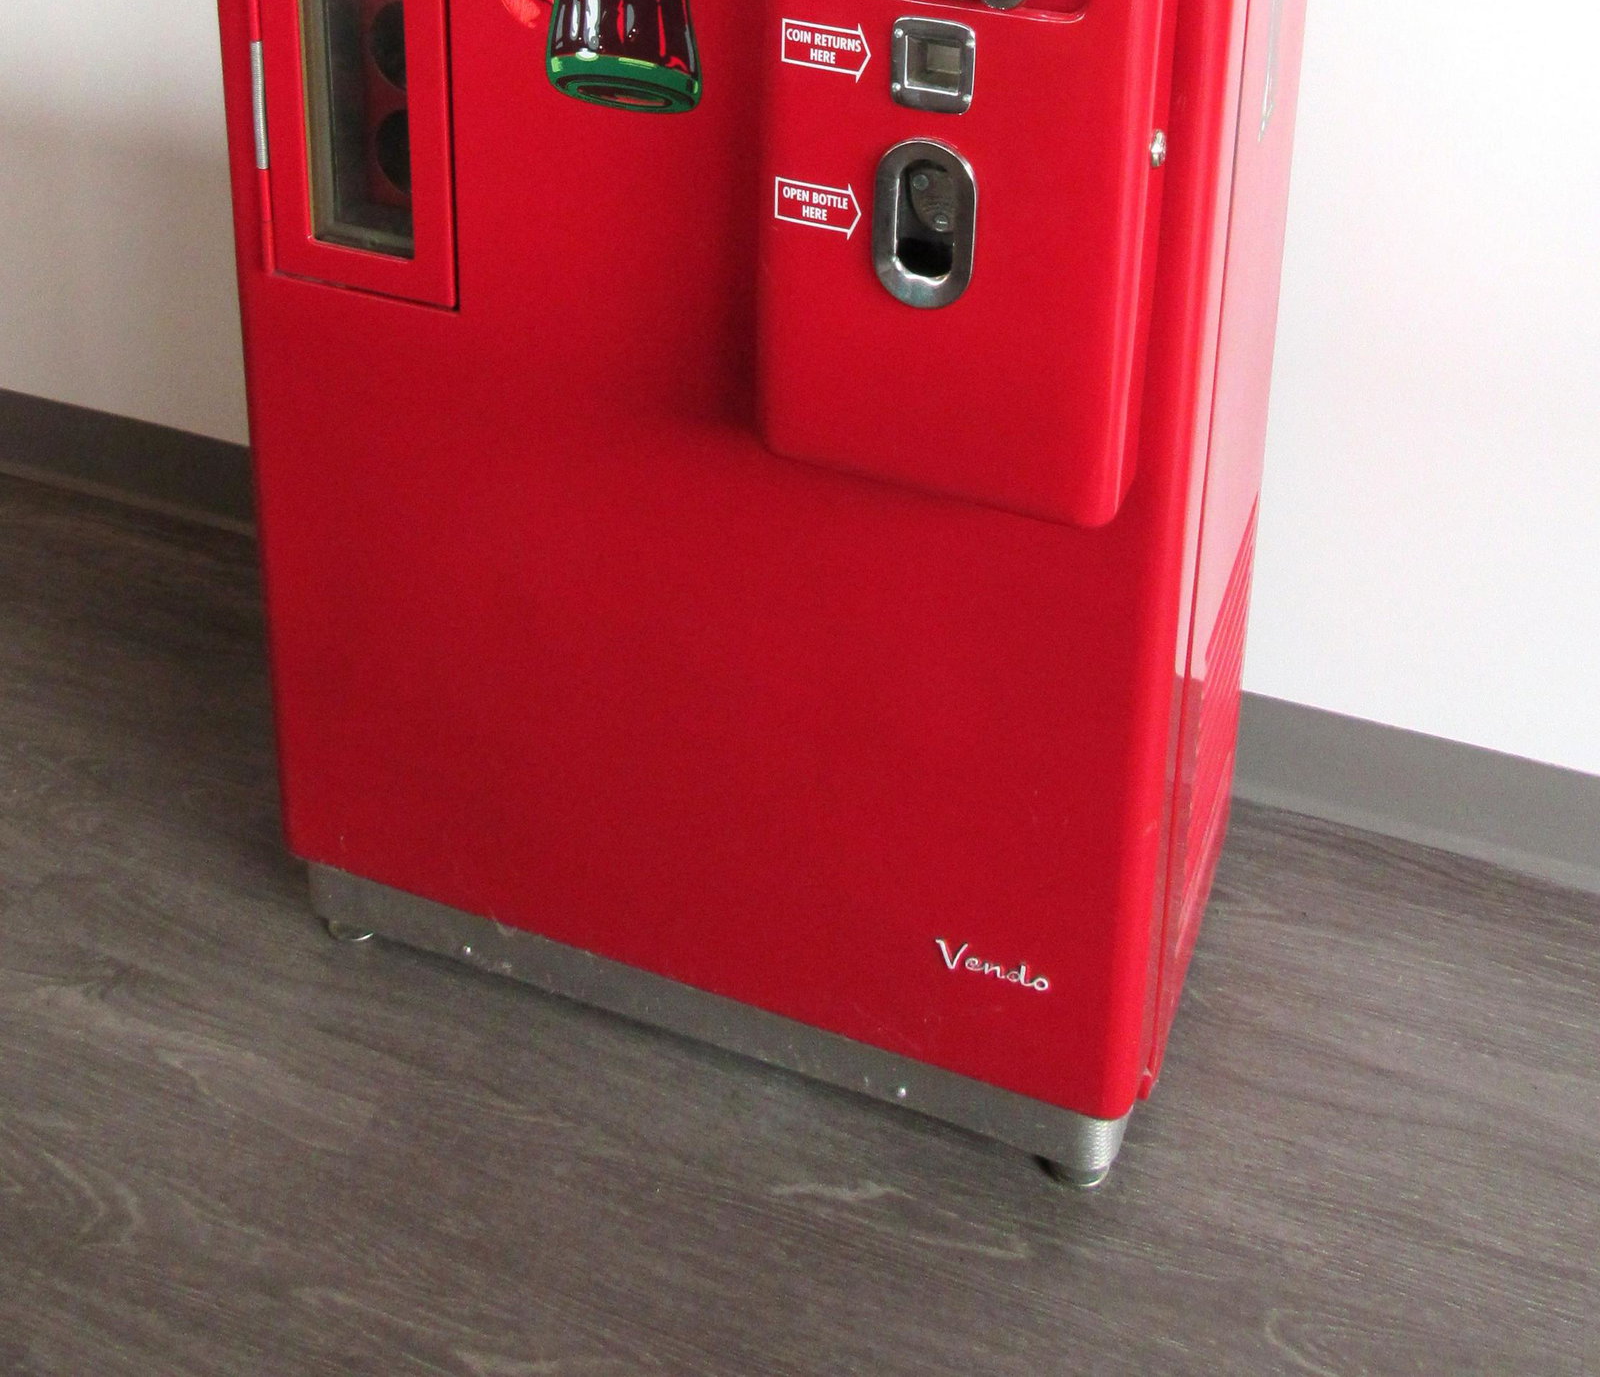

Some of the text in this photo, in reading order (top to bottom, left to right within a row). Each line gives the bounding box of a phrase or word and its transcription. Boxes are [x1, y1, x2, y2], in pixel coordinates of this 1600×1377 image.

[786, 28, 862, 52] COIN RETURNS
[810, 48, 836, 64] HERE
[782, 187, 848, 210] OPEN BOTTLE
[802, 206, 828, 221] HERE
[935, 938, 1049, 991] Vendo
